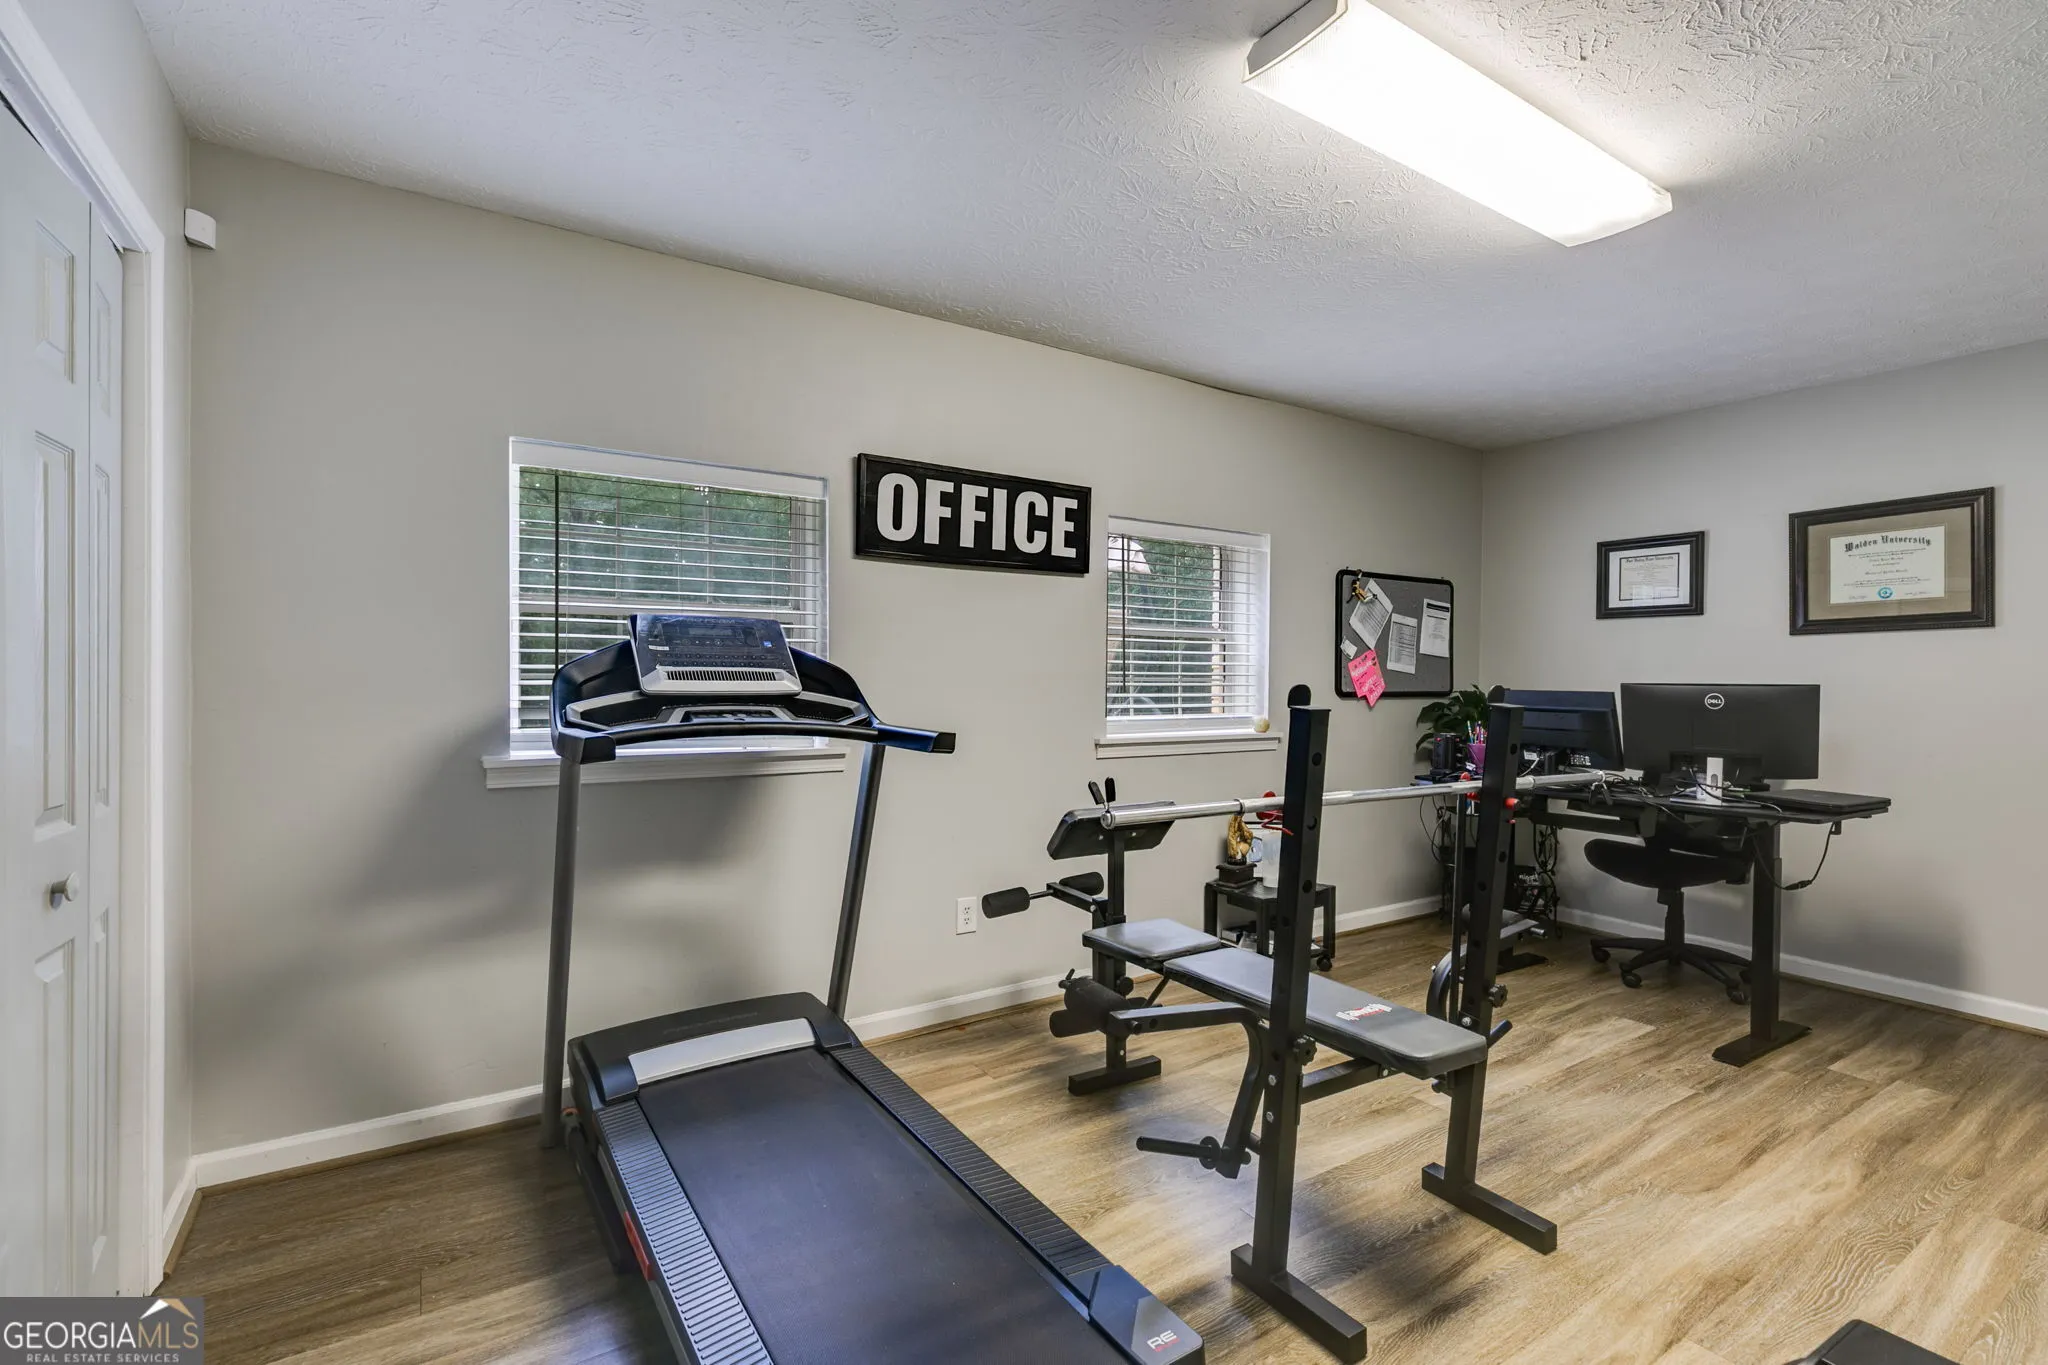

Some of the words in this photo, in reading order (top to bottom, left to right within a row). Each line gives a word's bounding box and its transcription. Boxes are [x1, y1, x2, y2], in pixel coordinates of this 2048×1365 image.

[876, 472, 1079, 559] OFFICE
[1844, 539, 1878, 553] Walden
[1880, 534, 1932, 547] University
[1146, 1330, 1178, 1350] RE
